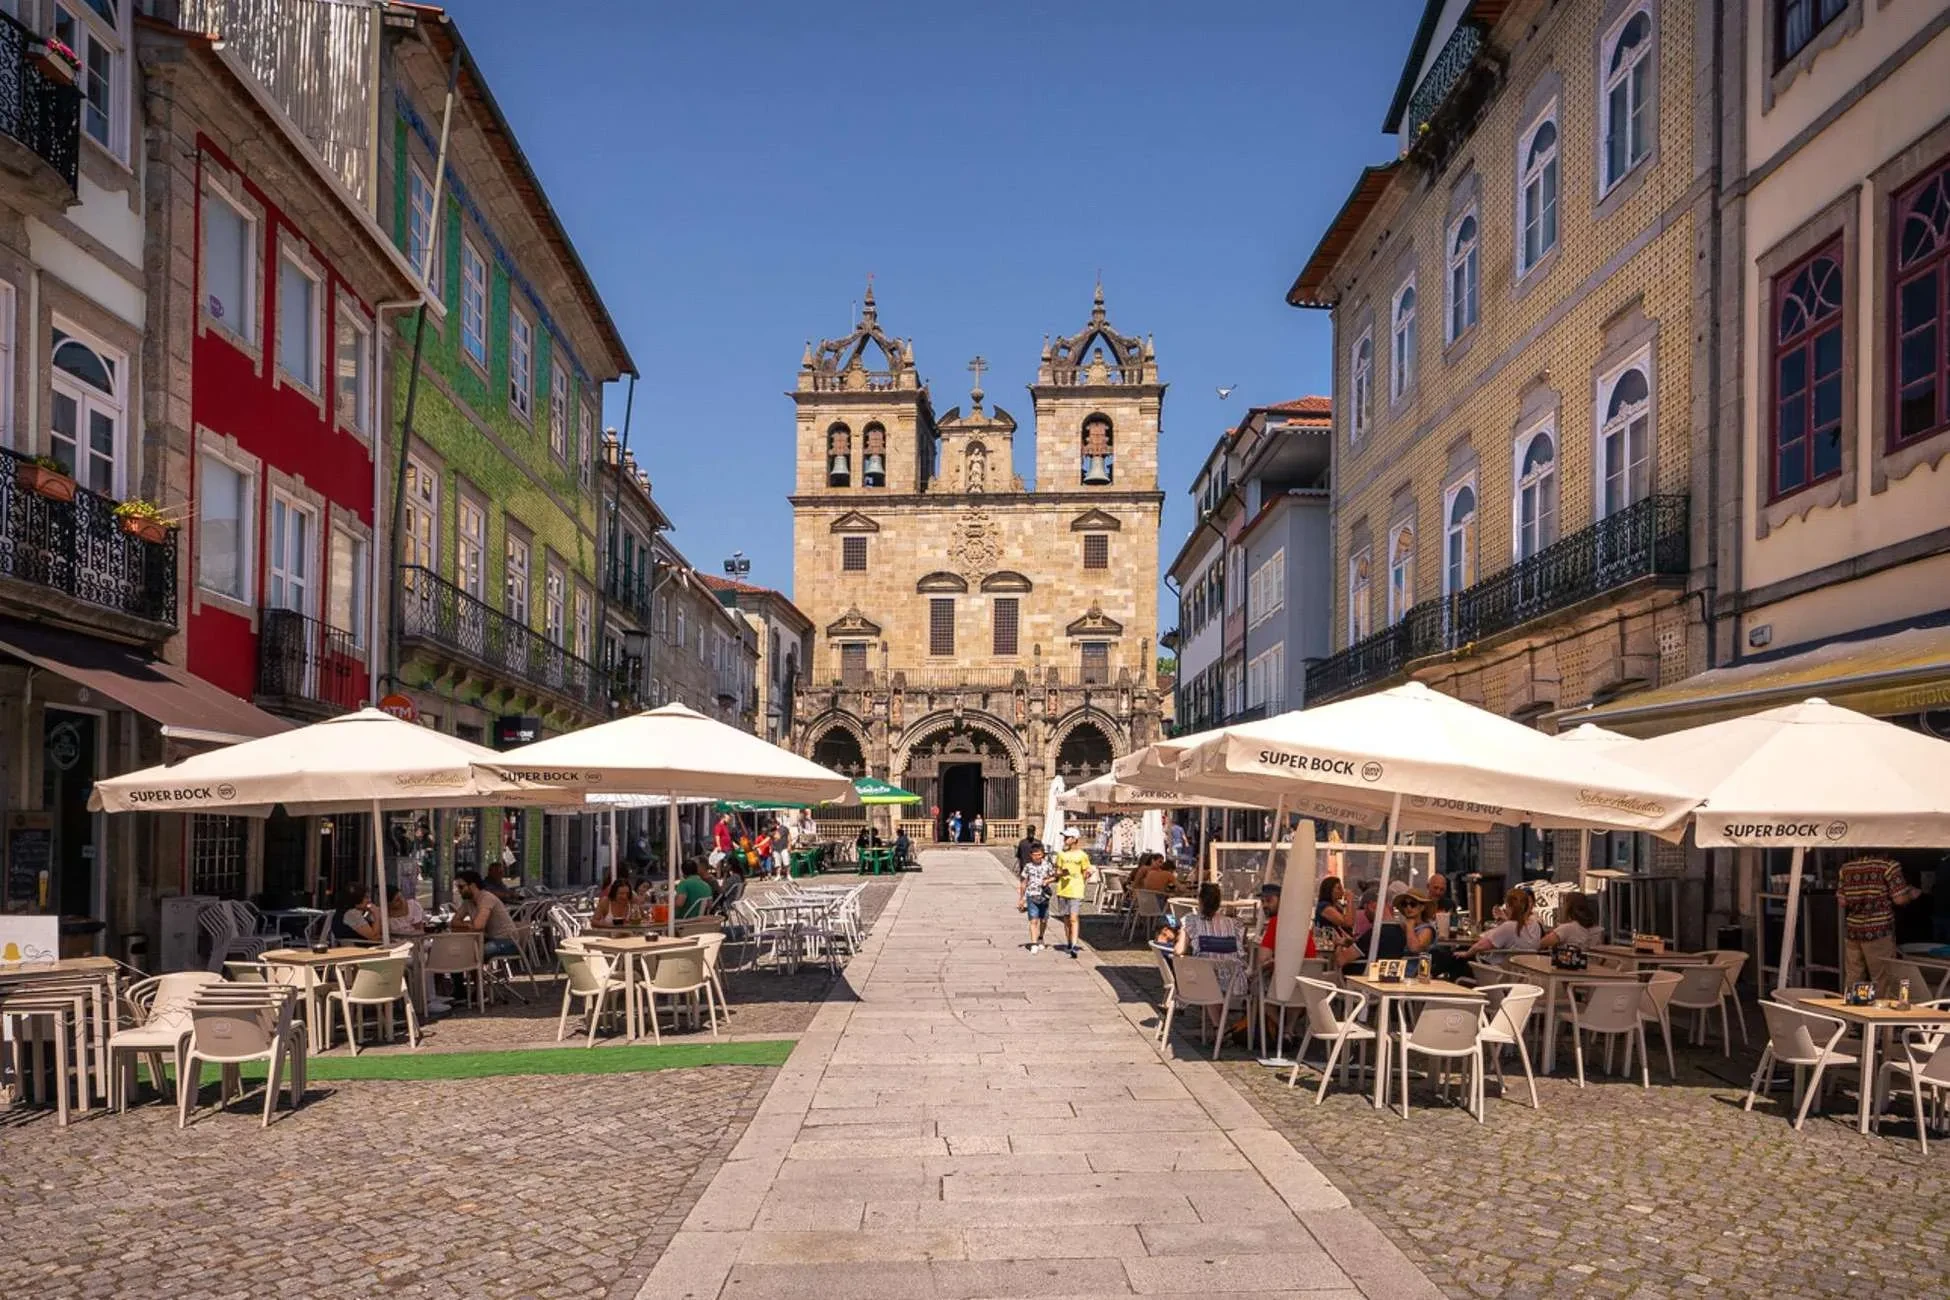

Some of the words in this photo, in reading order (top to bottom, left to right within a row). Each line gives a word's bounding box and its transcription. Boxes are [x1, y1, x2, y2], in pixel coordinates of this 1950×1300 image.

[1259, 750, 1309, 770] SUPER
[1310, 757, 1355, 776] BOCK
[499, 771, 541, 782] SUPER
[543, 771, 579, 781] BOCK
[129, 790, 172, 803] SUPER
[173, 787, 212, 801] BOCK
[1723, 824, 1773, 838] SUPER
[1775, 823, 1820, 837] BOCK
